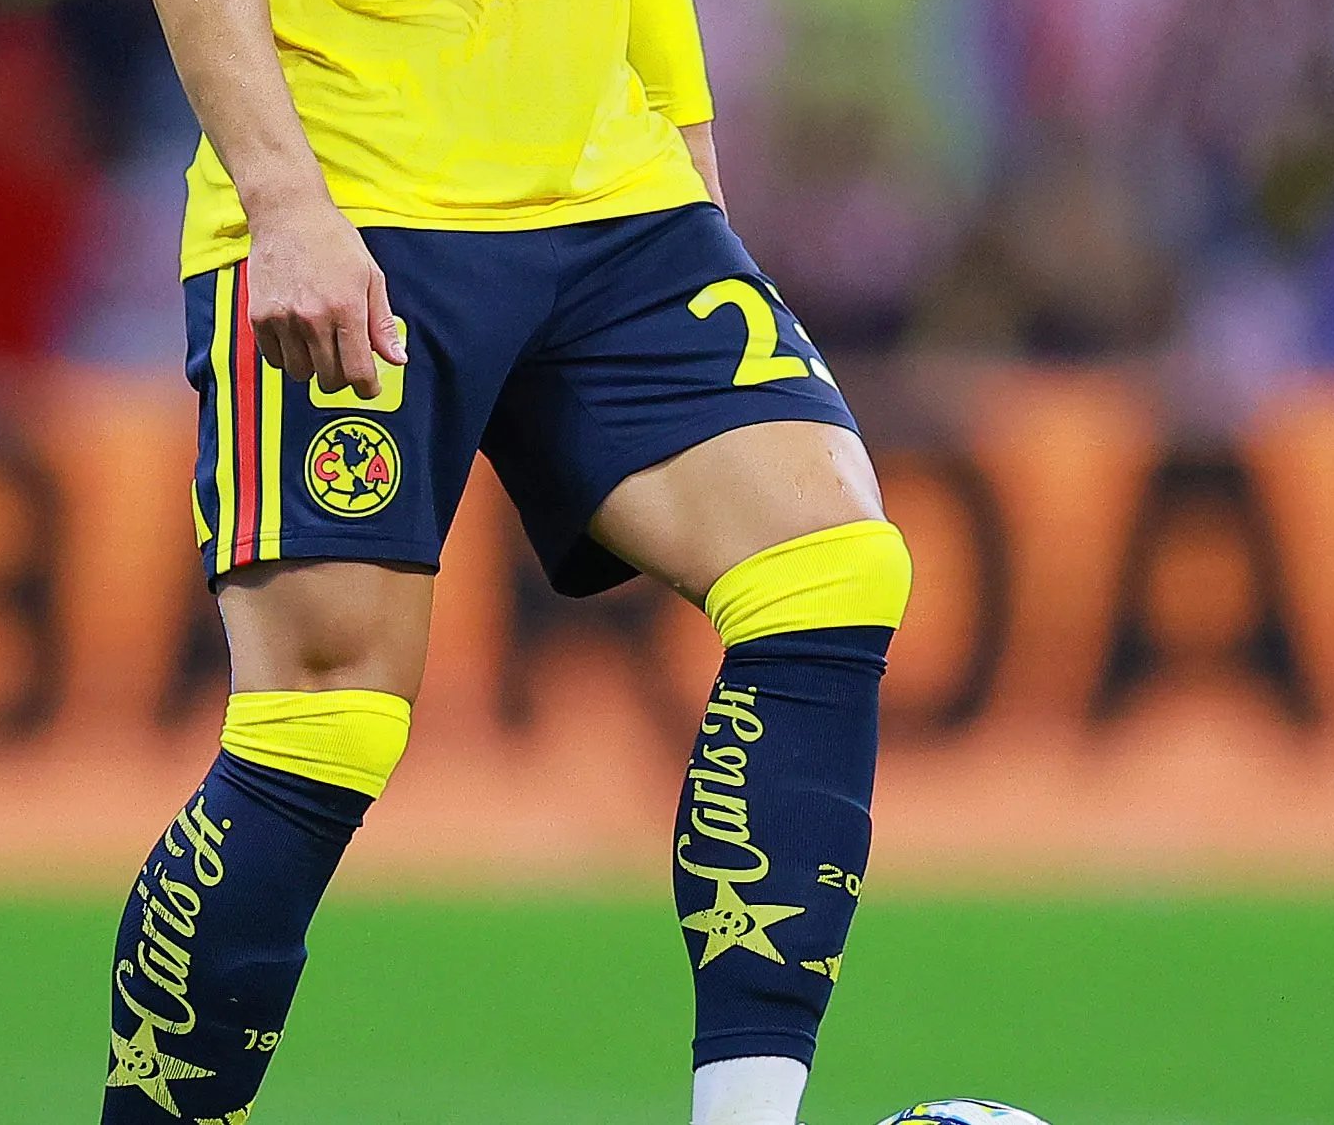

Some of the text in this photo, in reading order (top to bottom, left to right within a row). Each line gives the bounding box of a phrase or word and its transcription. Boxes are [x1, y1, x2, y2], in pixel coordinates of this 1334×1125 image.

[687, 278, 840, 387] 2
[817, 863, 862, 903] 20
[244, 1028, 285, 1052] 19
